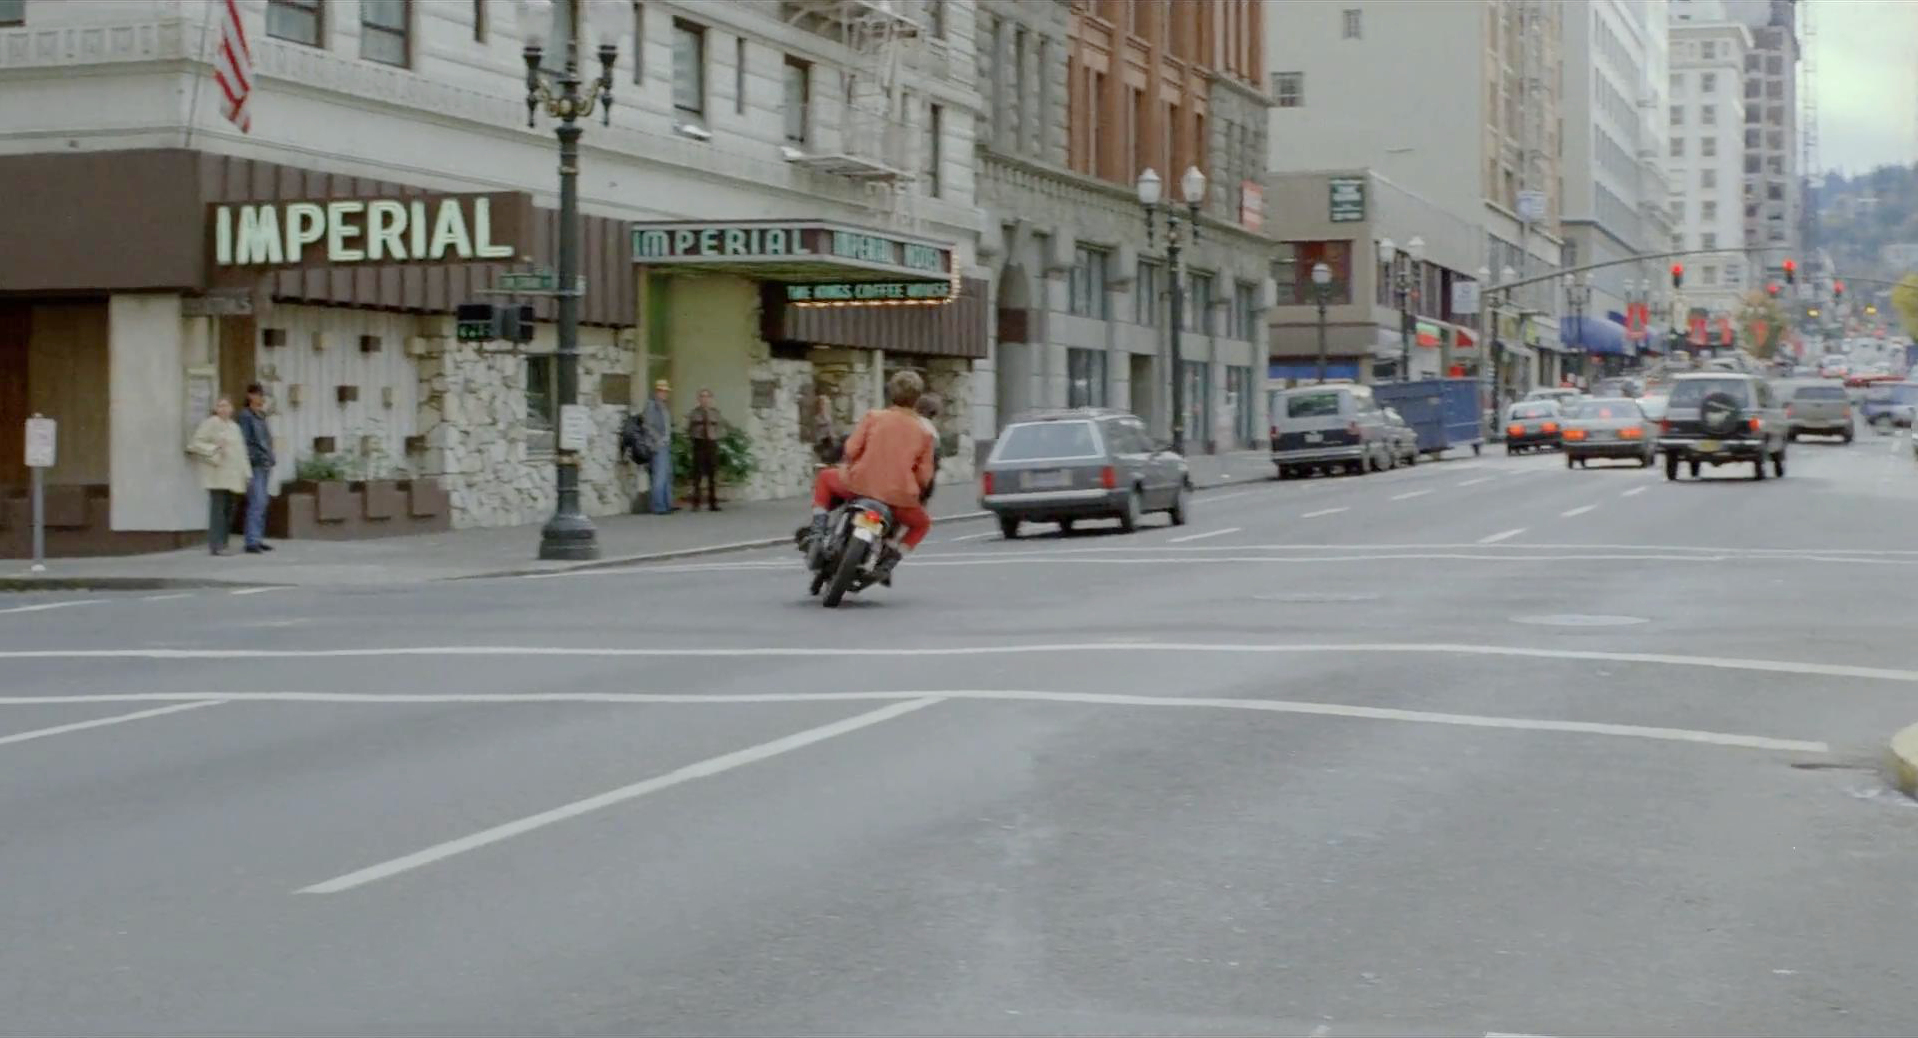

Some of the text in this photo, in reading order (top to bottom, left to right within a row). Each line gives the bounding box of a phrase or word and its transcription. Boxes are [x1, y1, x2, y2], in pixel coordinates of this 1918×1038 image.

[216, 198, 514, 264] IMPERIAL
[632, 228, 812, 255] IMPERIAL
[854, 284, 904, 298] COFFEE
